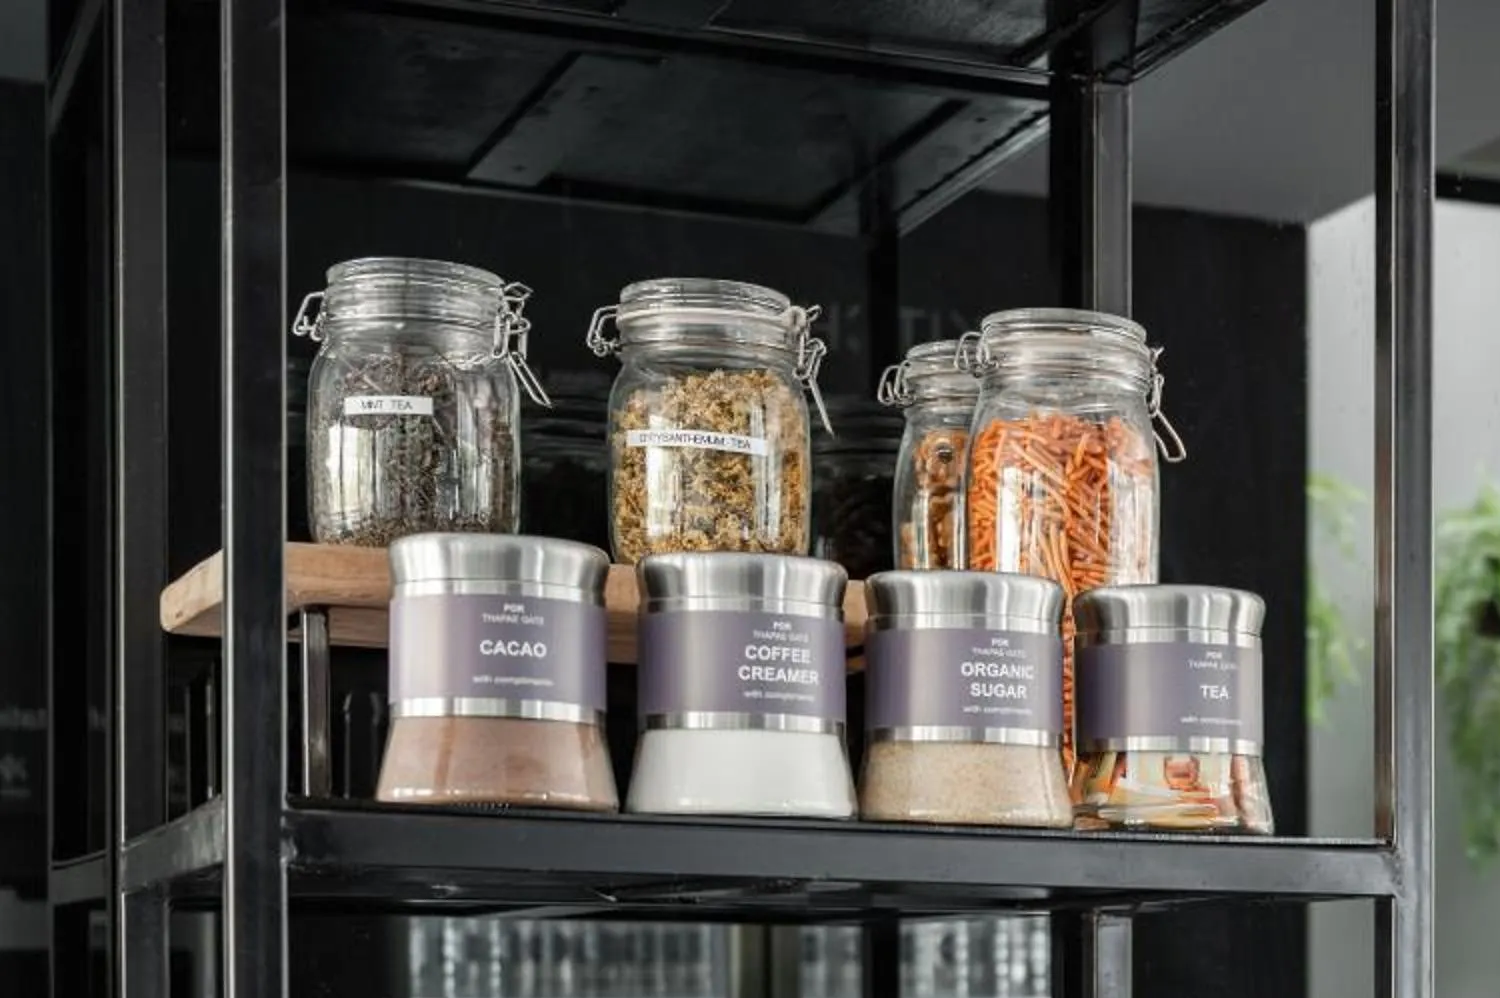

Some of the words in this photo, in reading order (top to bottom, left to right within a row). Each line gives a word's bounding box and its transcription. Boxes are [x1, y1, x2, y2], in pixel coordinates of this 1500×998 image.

[391, 399, 414, 411] TEA
[479, 639, 547, 658] CACAO
[745, 644, 812, 664] COFFEE
[738, 665, 819, 686] CREAMER
[960, 661, 1034, 680] ORGANIC
[970, 682, 1027, 699] SUGAR
[1200, 683, 1229, 700] TEA
